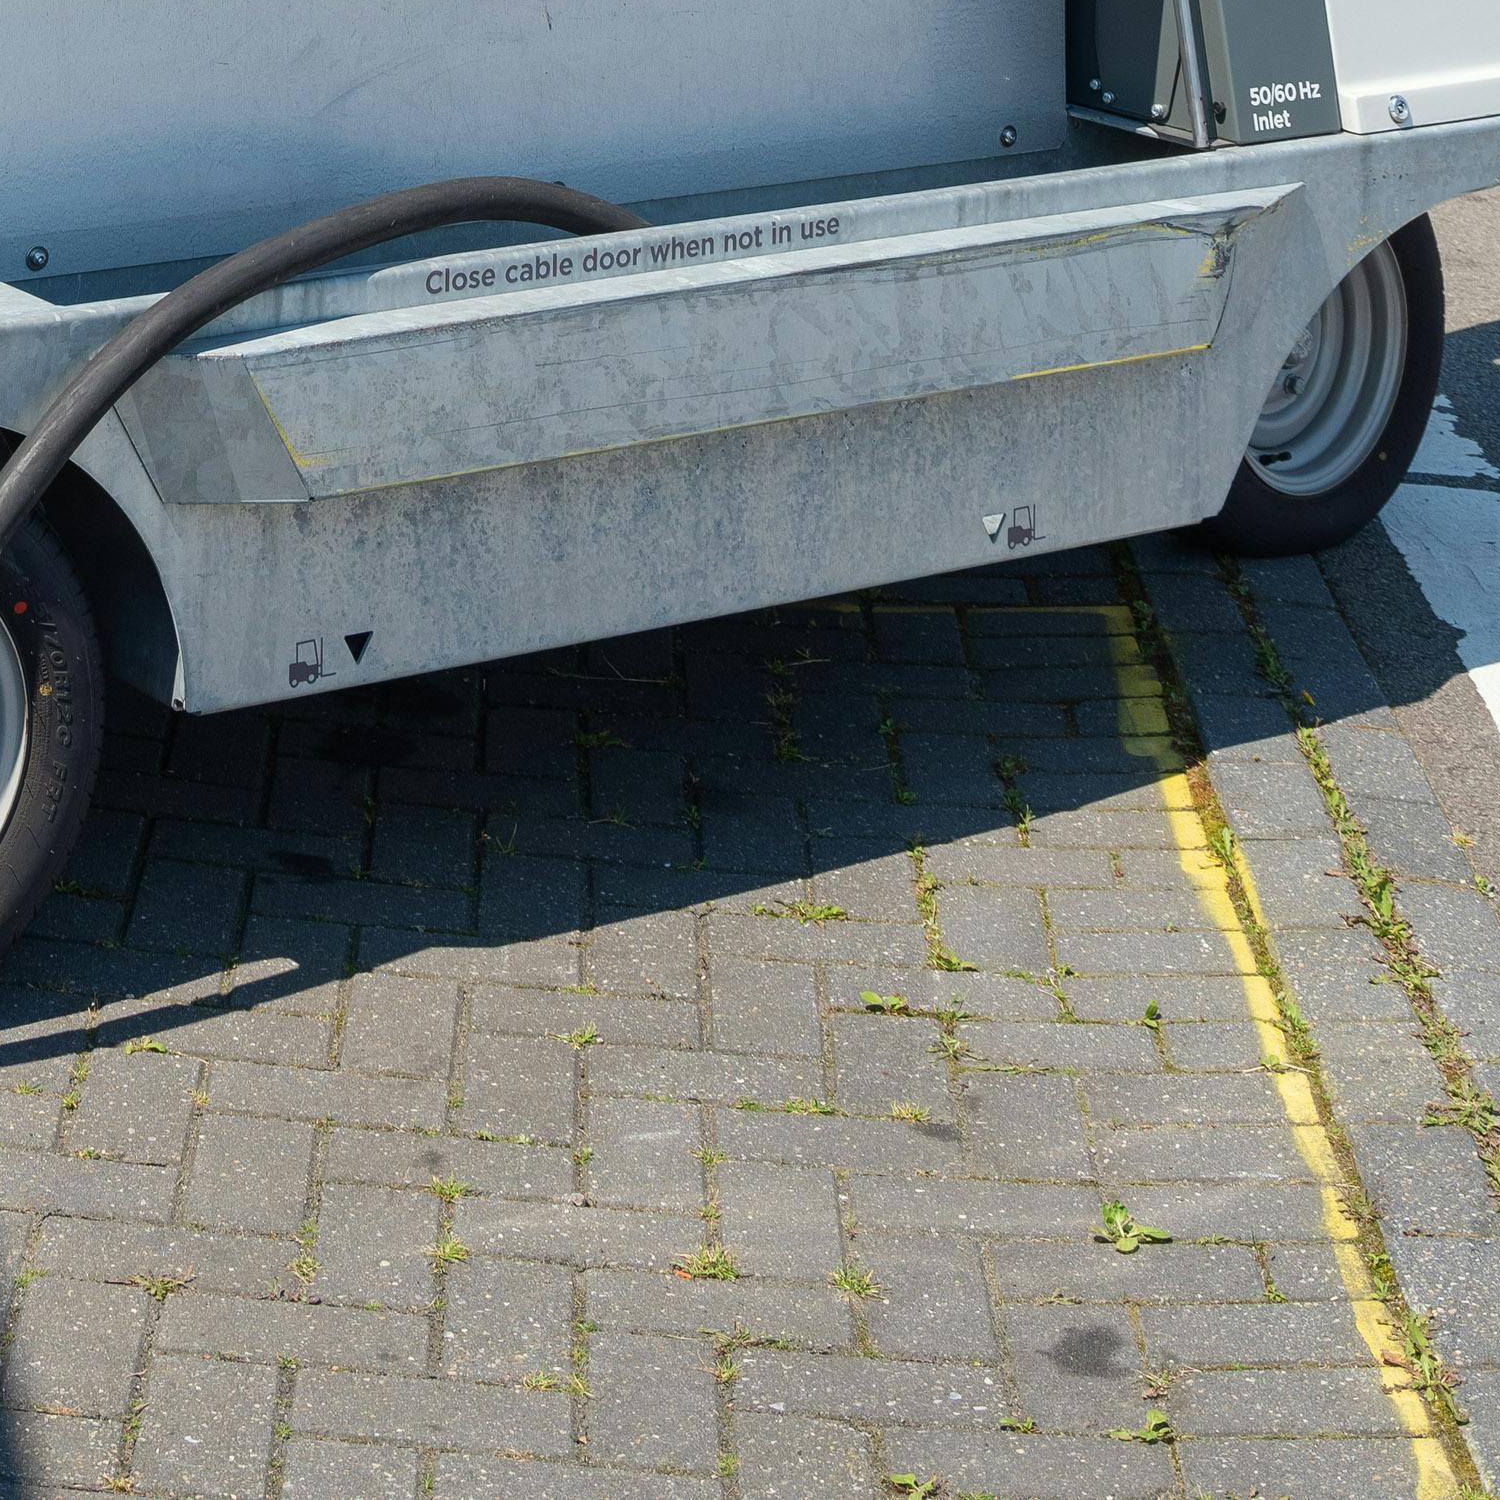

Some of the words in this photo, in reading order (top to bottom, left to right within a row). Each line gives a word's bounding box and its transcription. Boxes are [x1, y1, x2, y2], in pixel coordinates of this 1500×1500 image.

[1249, 82, 1297, 107] 50/60
[1298, 80, 1322, 100] Hz
[1253, 110, 1292, 132] Inlet
[425, 265, 496, 295] Close
[505, 253, 574, 283] cable
[582, 246, 641, 273] door
[650, 233, 716, 264] when
[724, 223, 763, 251] not
[771, 219, 793, 246] in
[800, 216, 841, 241] use
